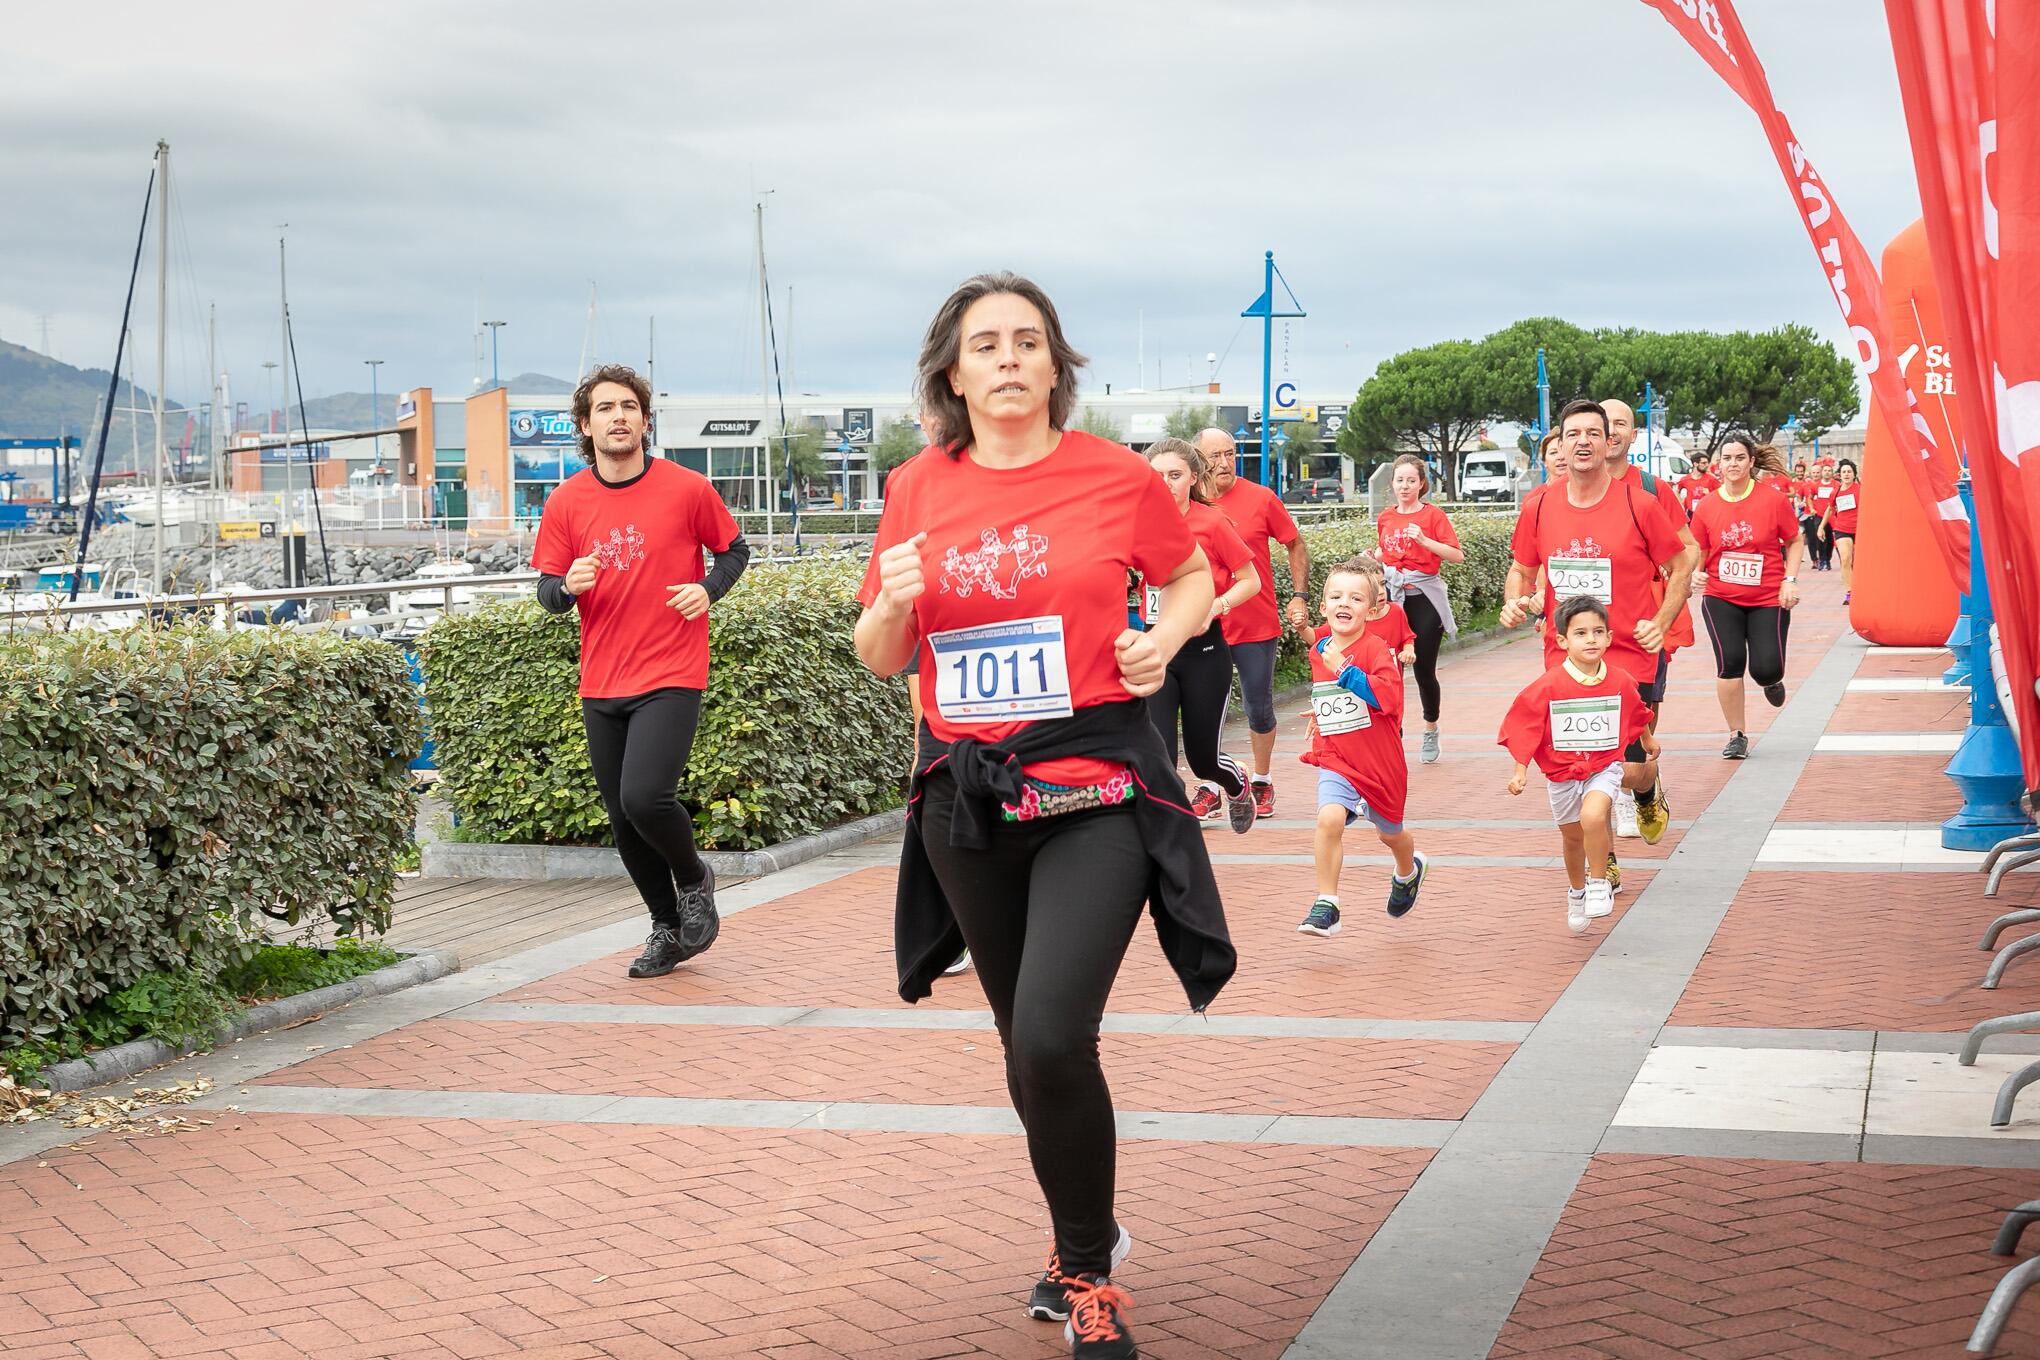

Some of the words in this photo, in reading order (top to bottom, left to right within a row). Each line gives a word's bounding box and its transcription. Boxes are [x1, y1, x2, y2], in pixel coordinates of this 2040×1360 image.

[1275, 382, 1297, 408] C
[1723, 560, 1758, 578] 3015
[1552, 570, 1604, 589] 2063
[952, 648, 1048, 699] 1011
[1563, 715, 1610, 733] 2064
